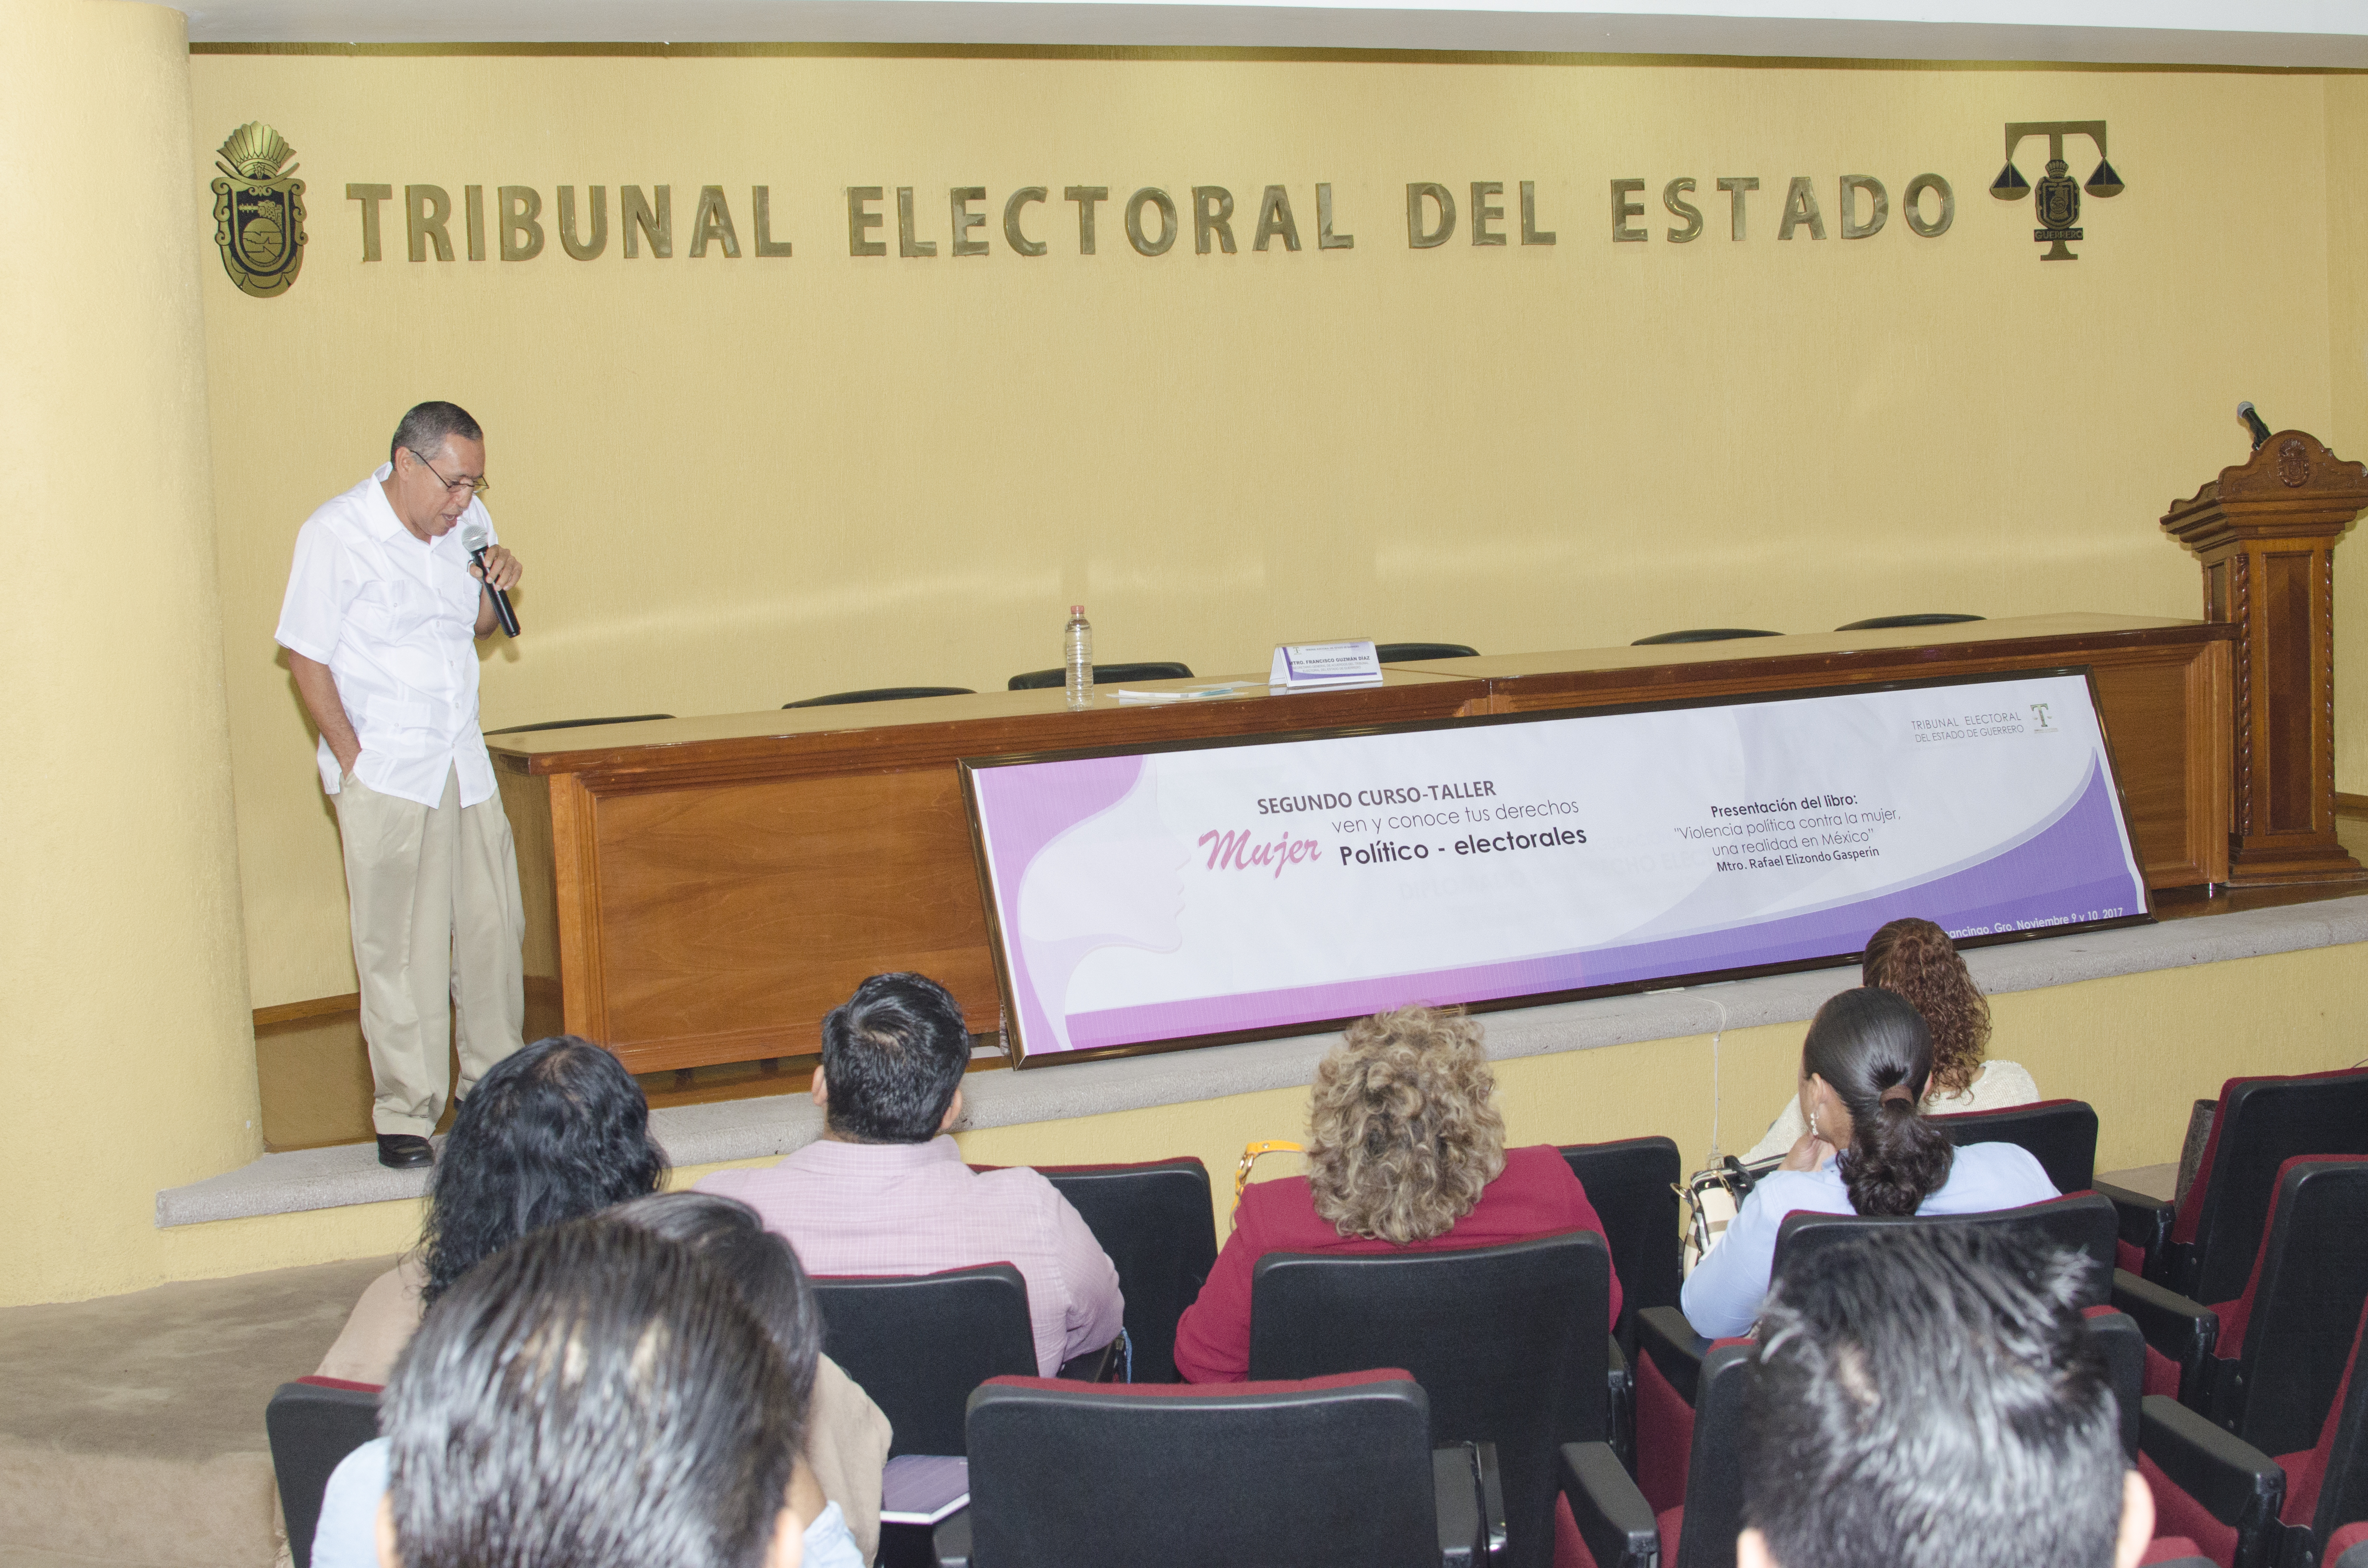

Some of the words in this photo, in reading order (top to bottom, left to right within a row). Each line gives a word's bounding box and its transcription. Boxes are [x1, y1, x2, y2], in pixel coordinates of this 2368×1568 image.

[346, 184, 792, 263] TRIBUNAL
[847, 183, 1354, 258] ELECTORAL
[1406, 181, 1556, 249] DEL
[1611, 173, 1954, 243] ESTADO
[2034, 230, 2083, 240] GUERRERO
[1911, 717, 1959, 730] TRIBUNAL
[1964, 712, 2022, 725] ELECTORAL
[1914, 733, 1931, 743] DEL
[1932, 730, 1965, 741] ESTADO
[1966, 728, 1979, 738] DE
[1979, 724, 2024, 736] GUERRERO
[1257, 792, 1352, 815] SEGUNDO
[1358, 780, 1497, 807] CURSO-TALLER
[1711, 797, 1798, 818] Presentación
[1801, 796, 1822, 809] del
[1824, 795, 1858, 807] libro:
[1332, 819, 1367, 833] ven
[1371, 818, 1381, 834] y
[1388, 811, 1460, 829] conoce
[1465, 807, 1490, 822] tus
[1495, 799, 1579, 820] derechos
[1746, 818, 1796, 837] política
[1799, 814, 1843, 829] contra
[1844, 812, 1858, 824] la
[1861, 808, 1900, 824] mujer,
[1198, 829, 1322, 879] Mujer
[1340, 840, 1429, 866] Político
[1455, 827, 1587, 855] electorales
[1712, 845, 1739, 857] una
[1741, 836, 1798, 854] realidad
[1801, 837, 1819, 847] en
[1716, 861, 1747, 872] Mtro.
[1749, 855, 1784, 869] Rafael
[1785, 851, 1831, 865] Elizondo
[1833, 846, 1880, 862] Gasperín
[1994, 922, 2015, 933] Gro.
[2016, 916, 2069, 930] Noviembre
[2071, 913, 2077, 922] 9
[2102, 907, 2123, 919] 2017
